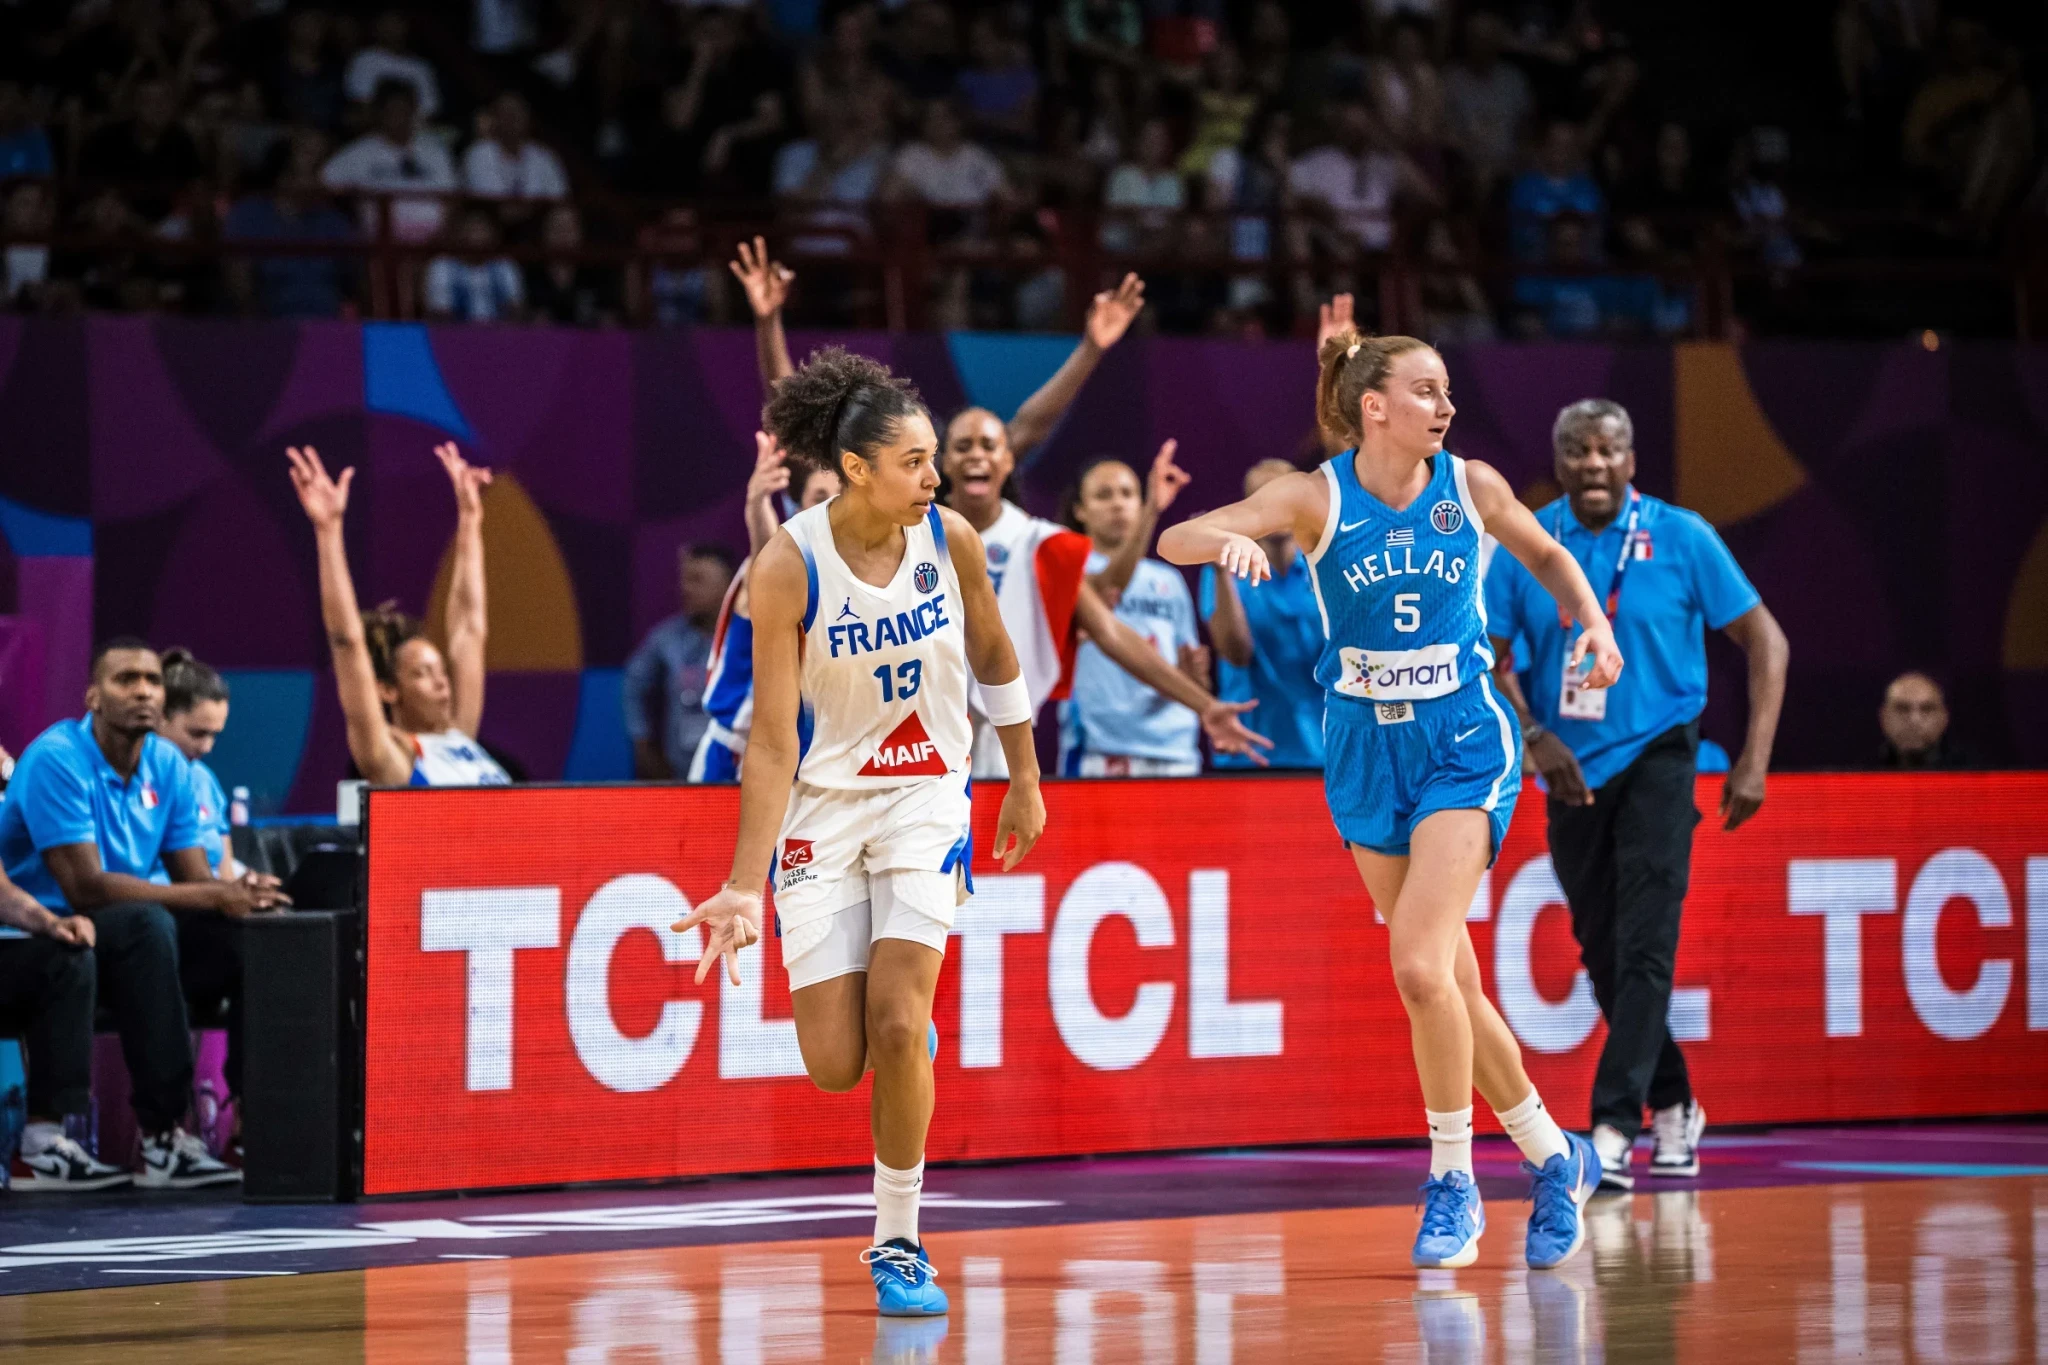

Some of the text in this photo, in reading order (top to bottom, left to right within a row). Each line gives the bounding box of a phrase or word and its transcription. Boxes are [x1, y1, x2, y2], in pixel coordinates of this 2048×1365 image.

[828, 594, 949, 658] FRANCE
[1394, 593, 1421, 632] 5
[873, 658, 922, 702] 13
[871, 740, 935, 769] MAIF
[948, 860, 1284, 1071] TCL
